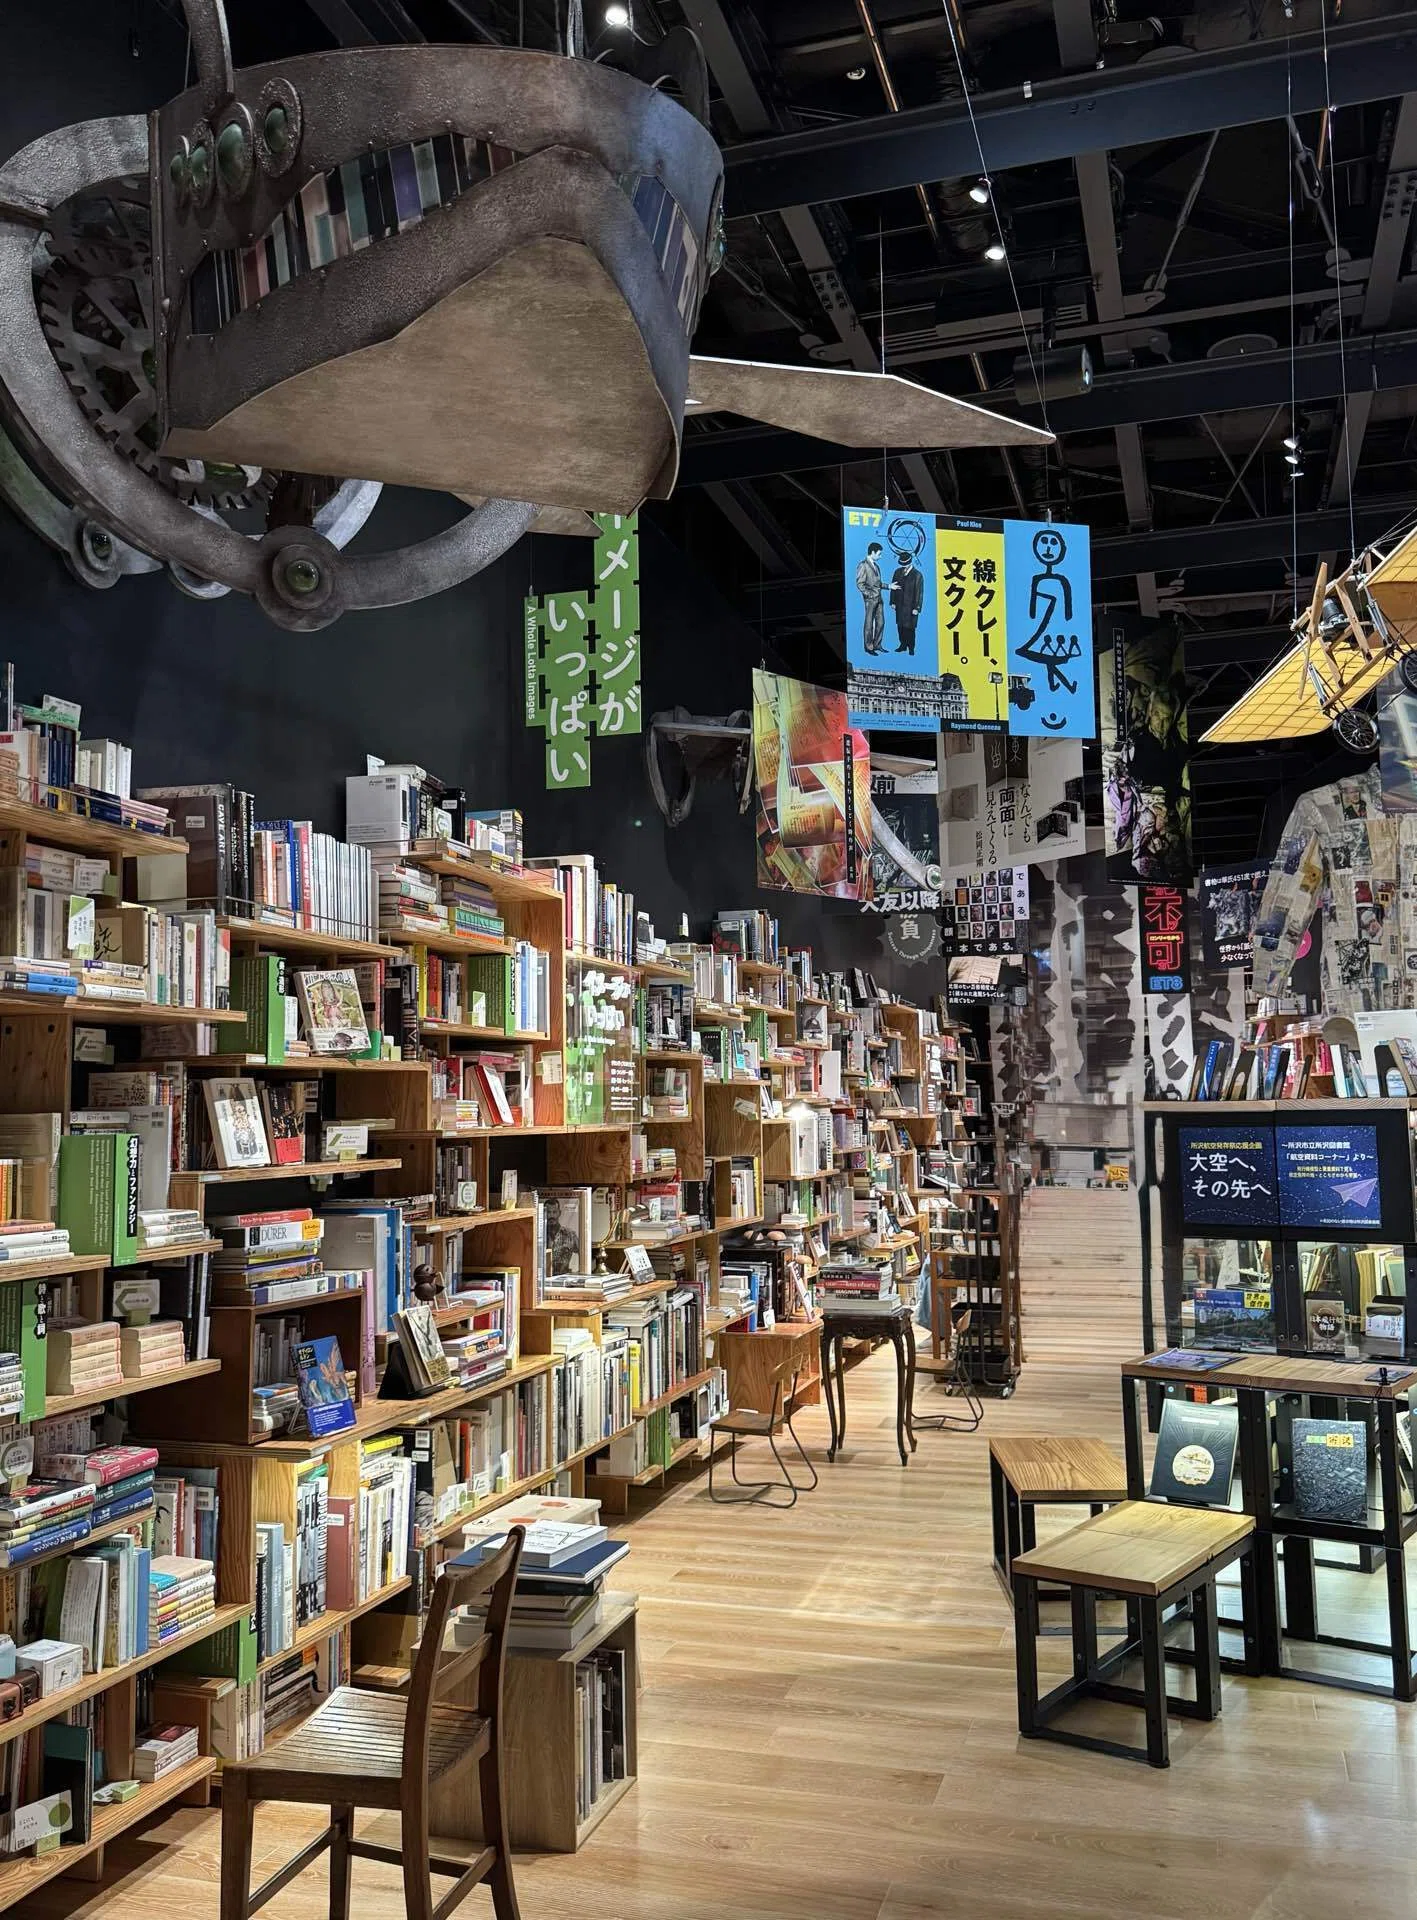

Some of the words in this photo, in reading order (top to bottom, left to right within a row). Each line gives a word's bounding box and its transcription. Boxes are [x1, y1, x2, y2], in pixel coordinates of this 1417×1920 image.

[848, 511, 883, 527] ET7
[527, 606, 536, 614] A
[599, 513, 641, 731] メージが
[943, 556, 969, 665] 文クノー。
[972, 558, 998, 666] 線クレー、
[527, 616, 536, 649] Whole
[527, 652, 536, 679] Lotta
[526, 682, 536, 720] Images
[549, 600, 588, 781] いっぱい
[951, 722, 976, 731] Raymond
[217, 803, 226, 833] CAVE
[999, 786, 1015, 838] 両面に
[1020, 783, 1032, 843] なんでも
[986, 790, 997, 865] 見えてくる
[217, 834, 226, 855] ART
[859, 890, 940, 913] 大友以降
[1149, 976, 1183, 990] ET8
[1189, 1152, 1257, 1172] 大空へ、
[1191, 1176, 1272, 1198] その先へ
[261, 1223, 288, 1242] DÜRER
[317, 1555, 328, 1579] DAVID
